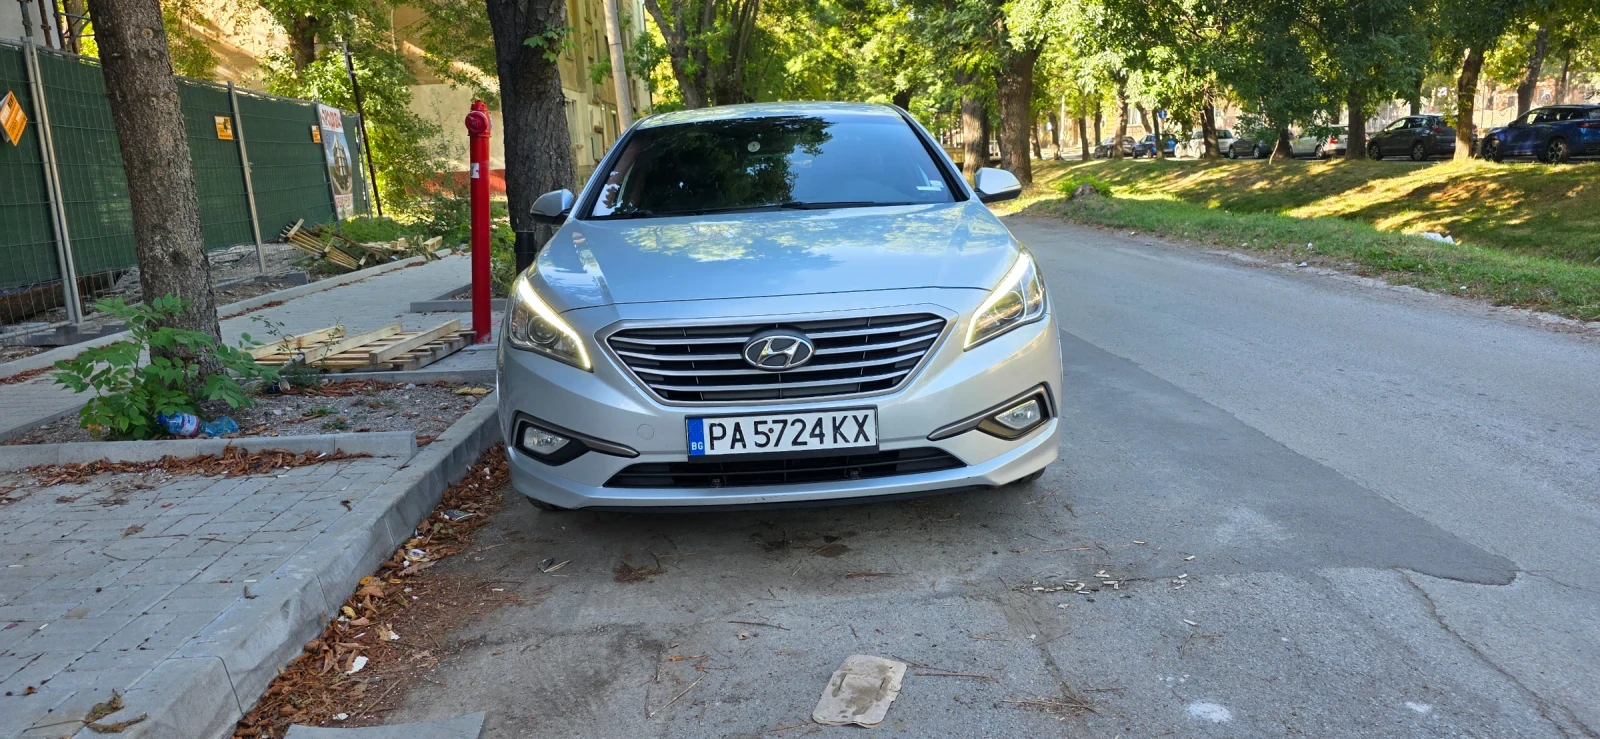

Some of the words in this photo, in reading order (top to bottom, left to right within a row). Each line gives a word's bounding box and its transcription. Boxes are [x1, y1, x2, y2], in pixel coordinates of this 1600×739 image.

[708, 422, 747, 451] PA
[753, 417, 826, 448] 5724
[832, 414, 871, 445] KX
[691, 441, 704, 451] BG
